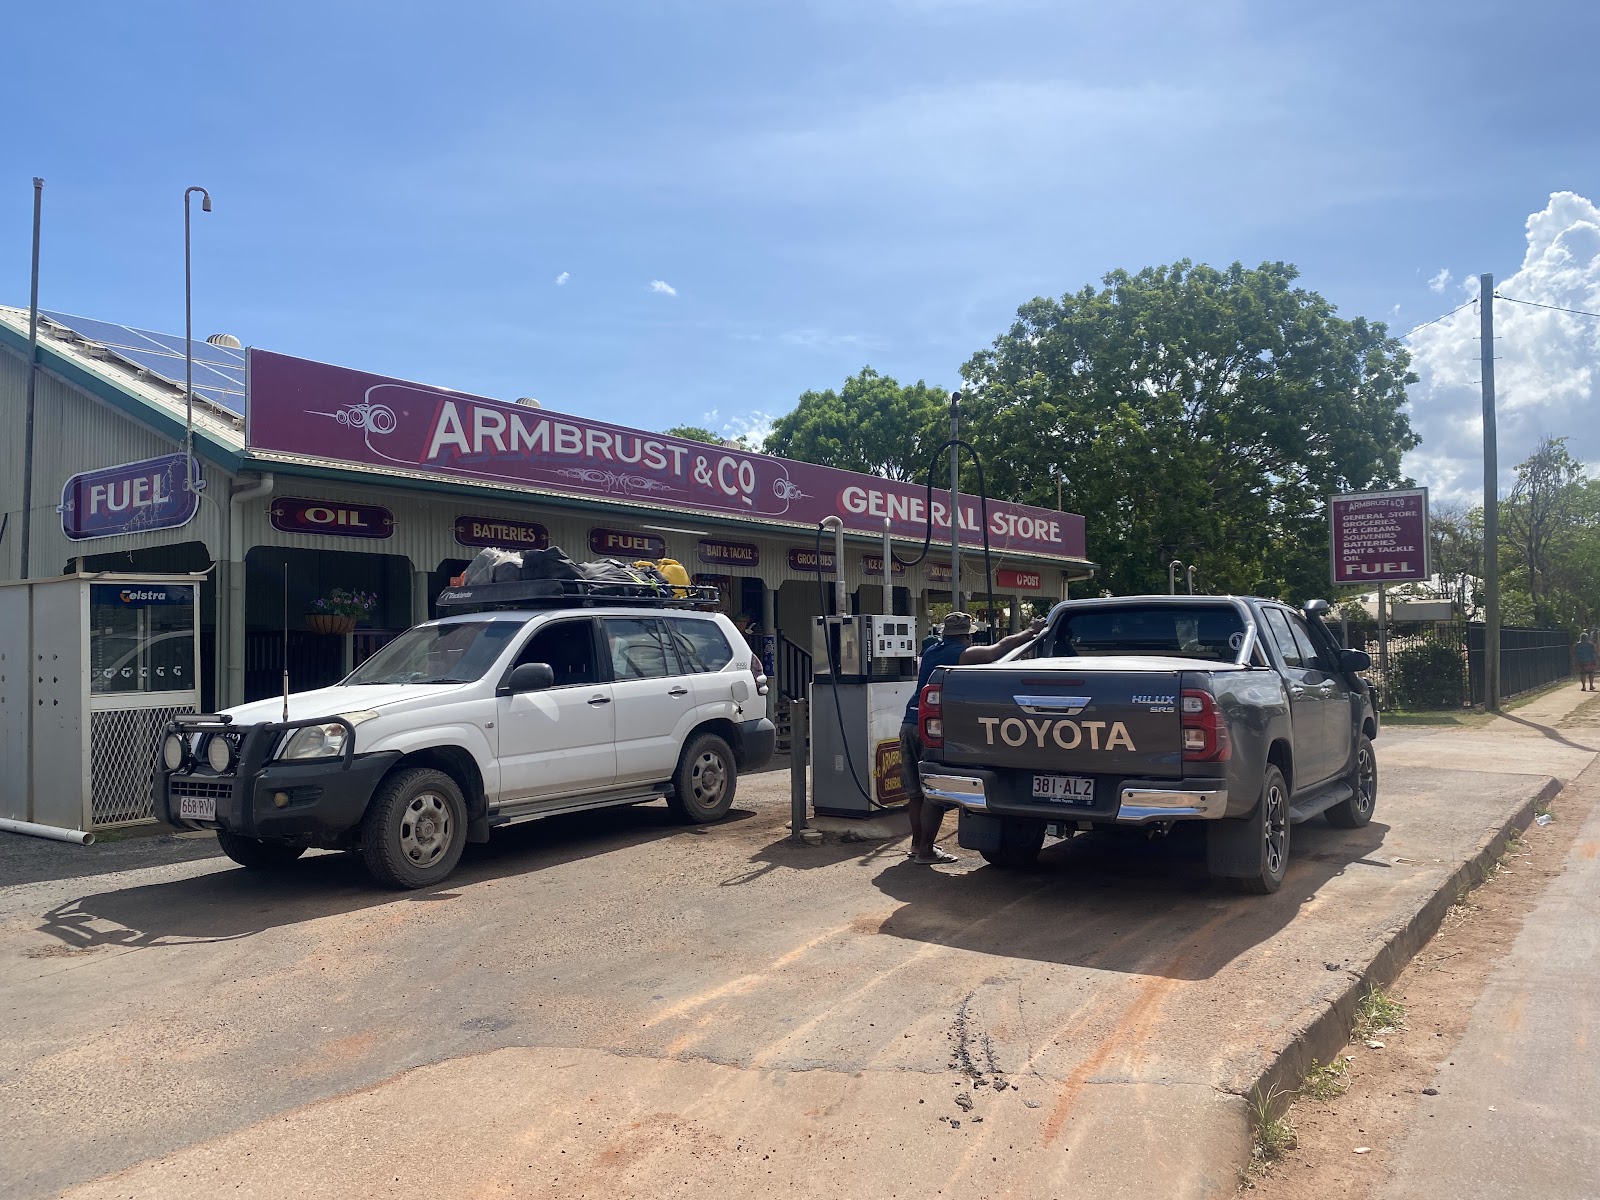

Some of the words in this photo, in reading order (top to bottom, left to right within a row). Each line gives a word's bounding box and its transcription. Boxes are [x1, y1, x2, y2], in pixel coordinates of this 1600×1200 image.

[427, 400, 689, 476] ARMBRUST
[693, 455, 713, 487] &
[90, 473, 170, 515] FUEL
[1349, 500, 1390, 512] ARMBRUST
[304, 506, 368, 527] OIL
[841, 486, 980, 532] GENERAL
[990, 511, 1062, 543] STORE
[1343, 512, 1385, 520] GENERAL
[1343, 519, 1397, 528] GROCERIES
[1361, 525, 1401, 533] CREAMS
[472, 523, 536, 543] BATTERIES
[1344, 532, 1397, 541] SOUVENIRS
[607, 534, 653, 551] FUEL
[1344, 540, 1397, 548] BATTERIES
[706, 544, 721, 557] BAIT
[722, 546, 729, 558] &
[730, 546, 753, 560] TACKLE
[868, 559, 878, 569] ICE
[879, 560, 901, 572] CMS
[931, 566, 952, 577] SOUVEN
[1346, 562, 1415, 574] FUEL
[1023, 575, 1039, 587] POST
[120, 590, 166, 603] Telstra
[1131, 695, 1175, 704] HILUX
[977, 717, 1136, 753] TOYOTA
